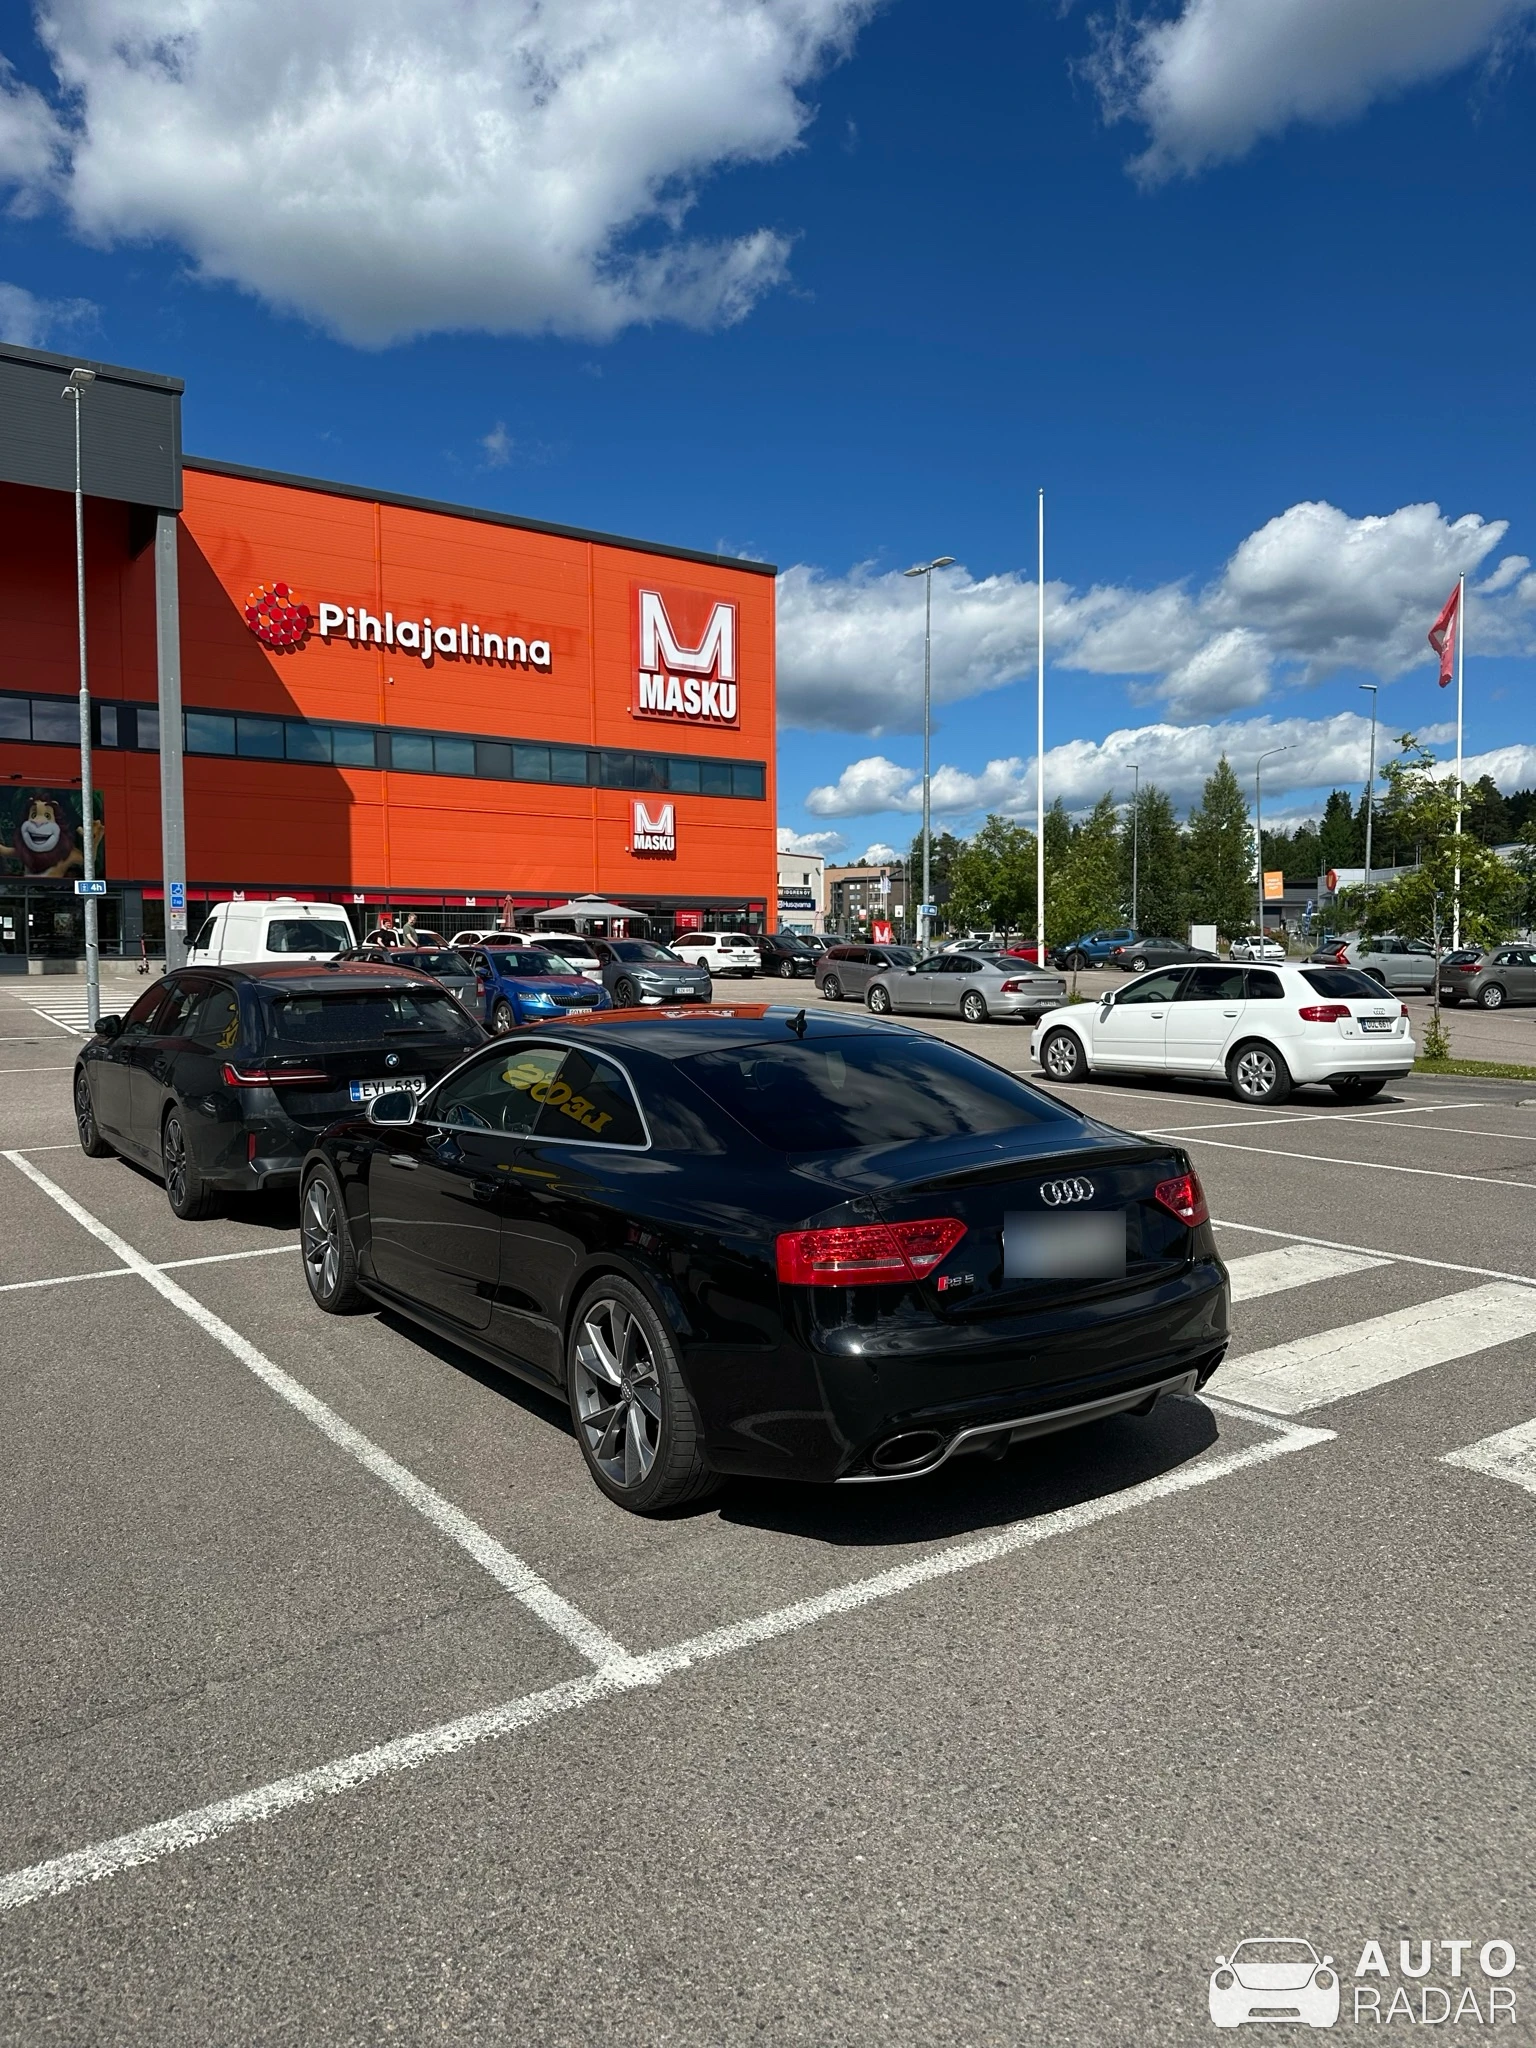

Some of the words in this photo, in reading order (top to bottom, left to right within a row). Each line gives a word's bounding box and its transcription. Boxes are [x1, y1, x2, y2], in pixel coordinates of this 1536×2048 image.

[319, 602, 550, 666] Pihlajalinna
[639, 672, 736, 719] MASKU
[634, 834, 675, 851] MASKU
[90, 883, 102, 891] 4h
[782, 900, 811, 909] Husqvarna
